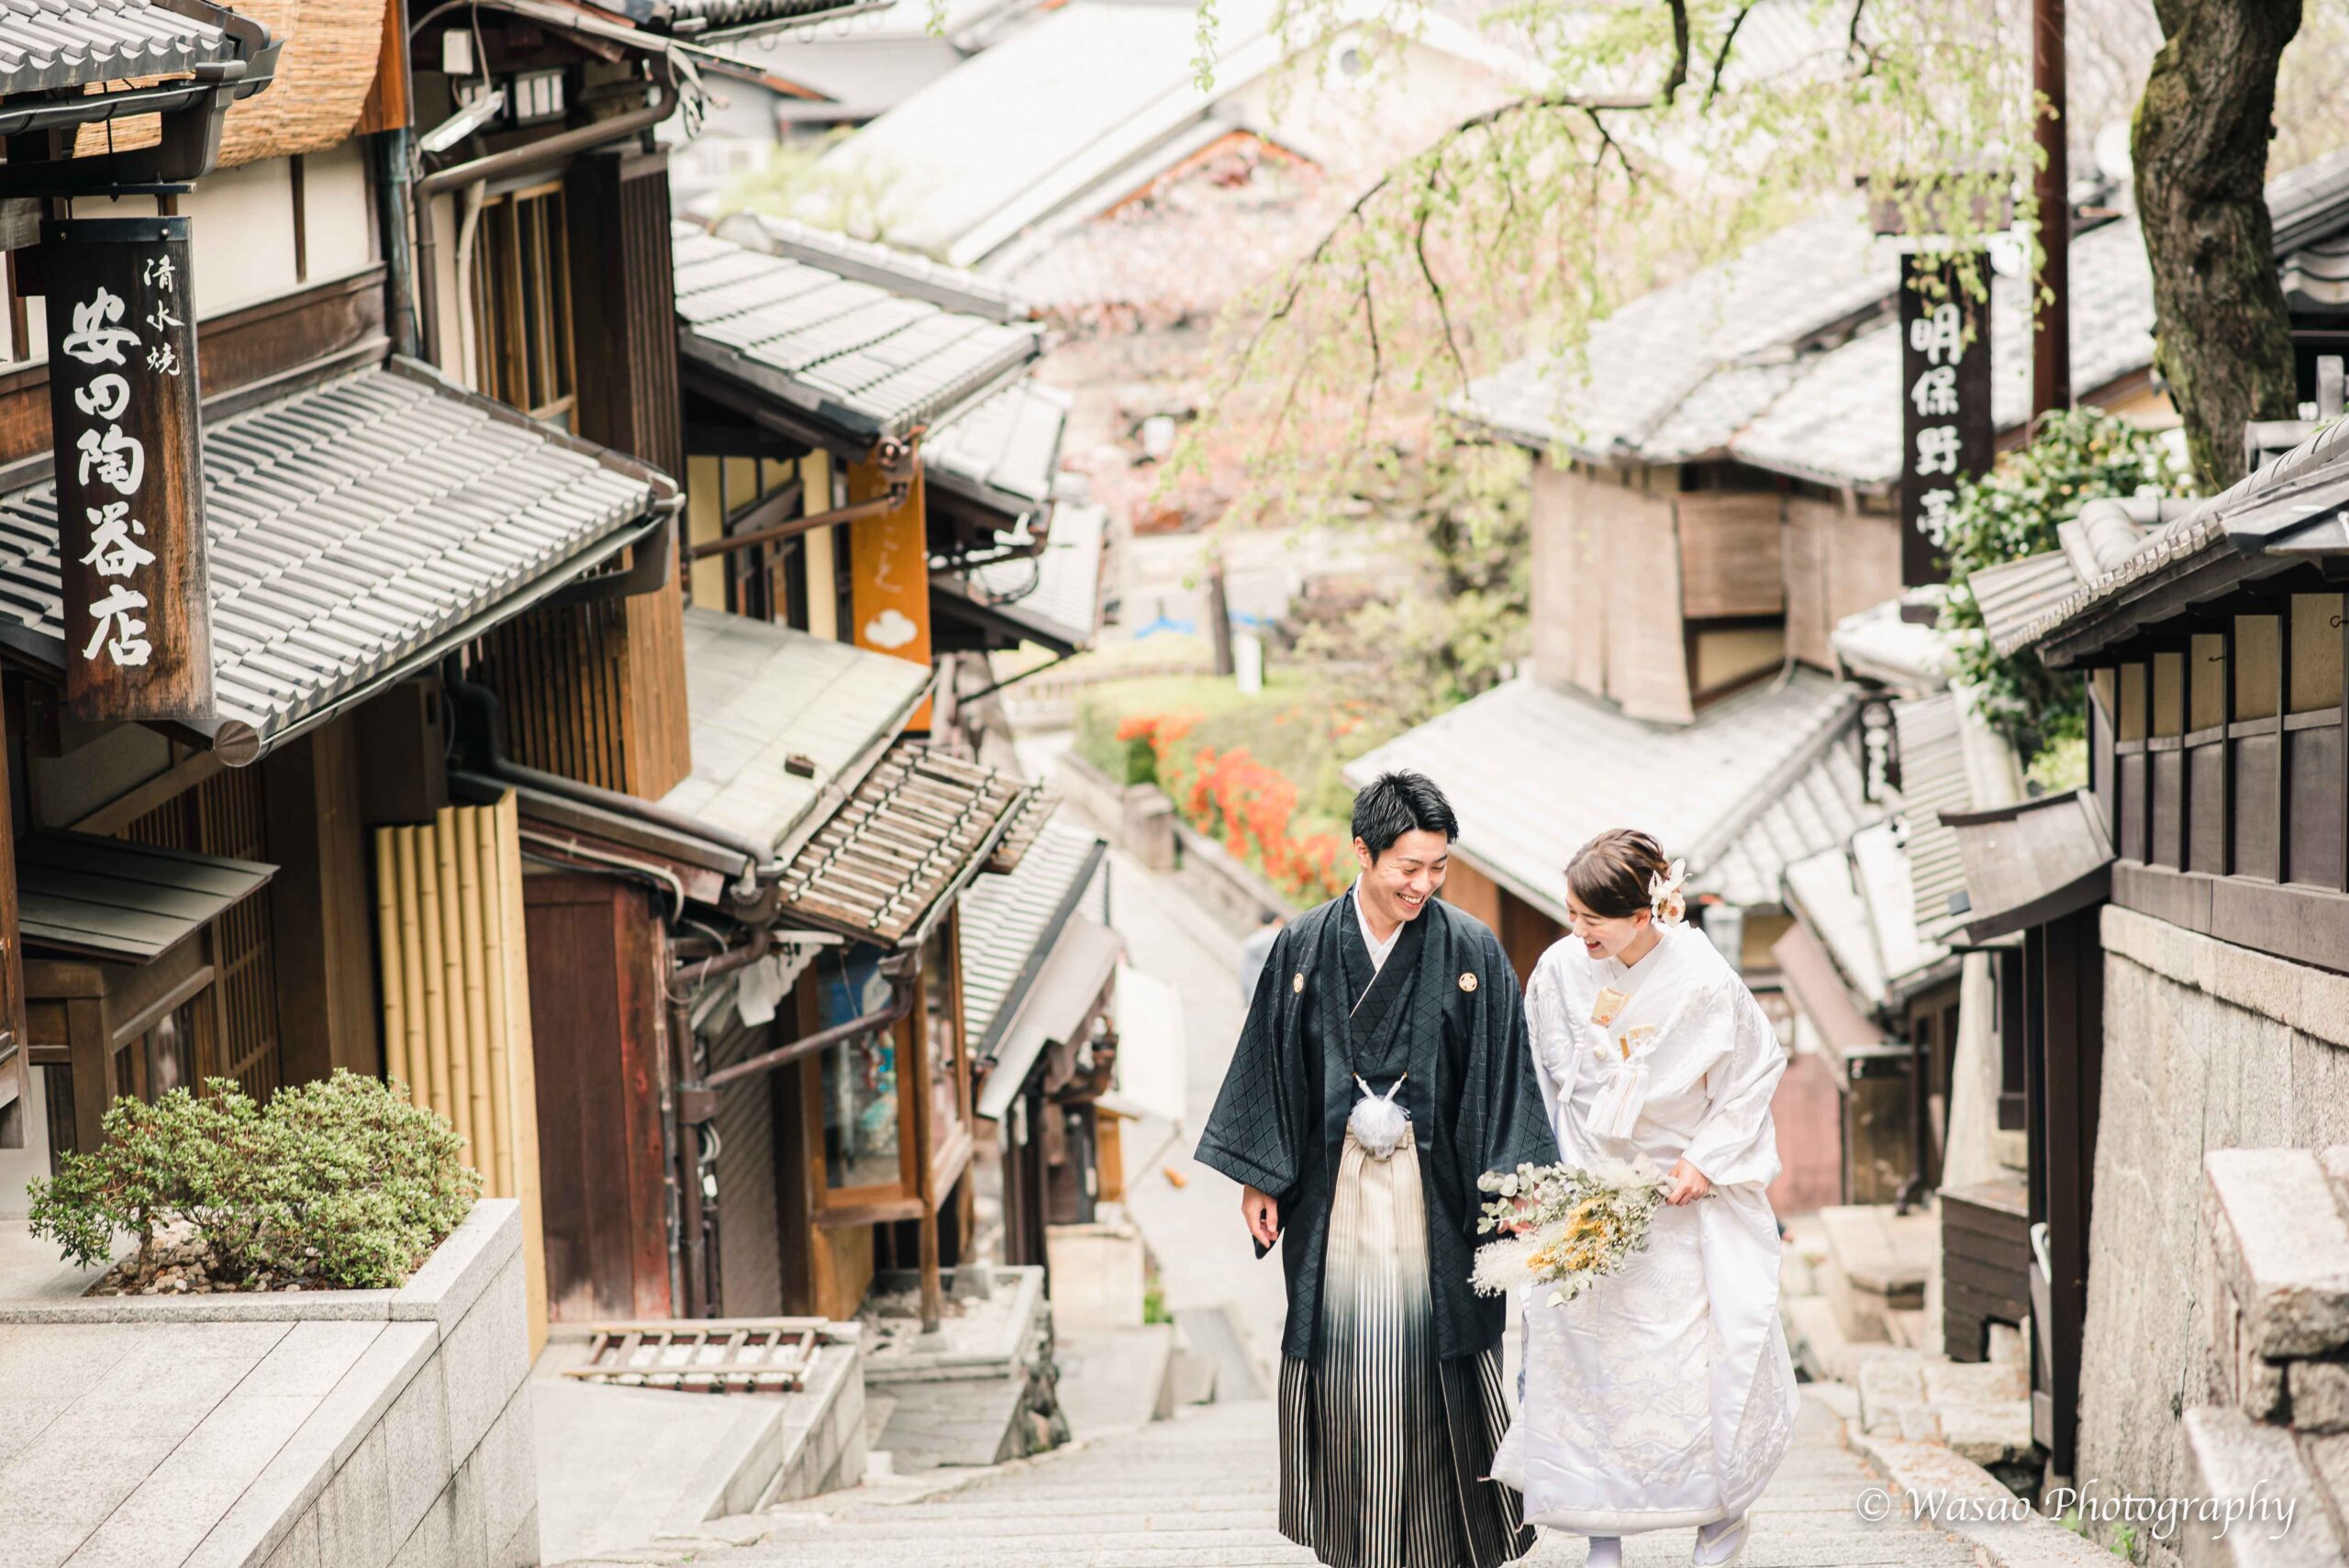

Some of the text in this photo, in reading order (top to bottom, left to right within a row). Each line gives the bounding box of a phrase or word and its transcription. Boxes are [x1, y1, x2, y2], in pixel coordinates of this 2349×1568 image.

[62, 286, 155, 666] 安田陶器店
